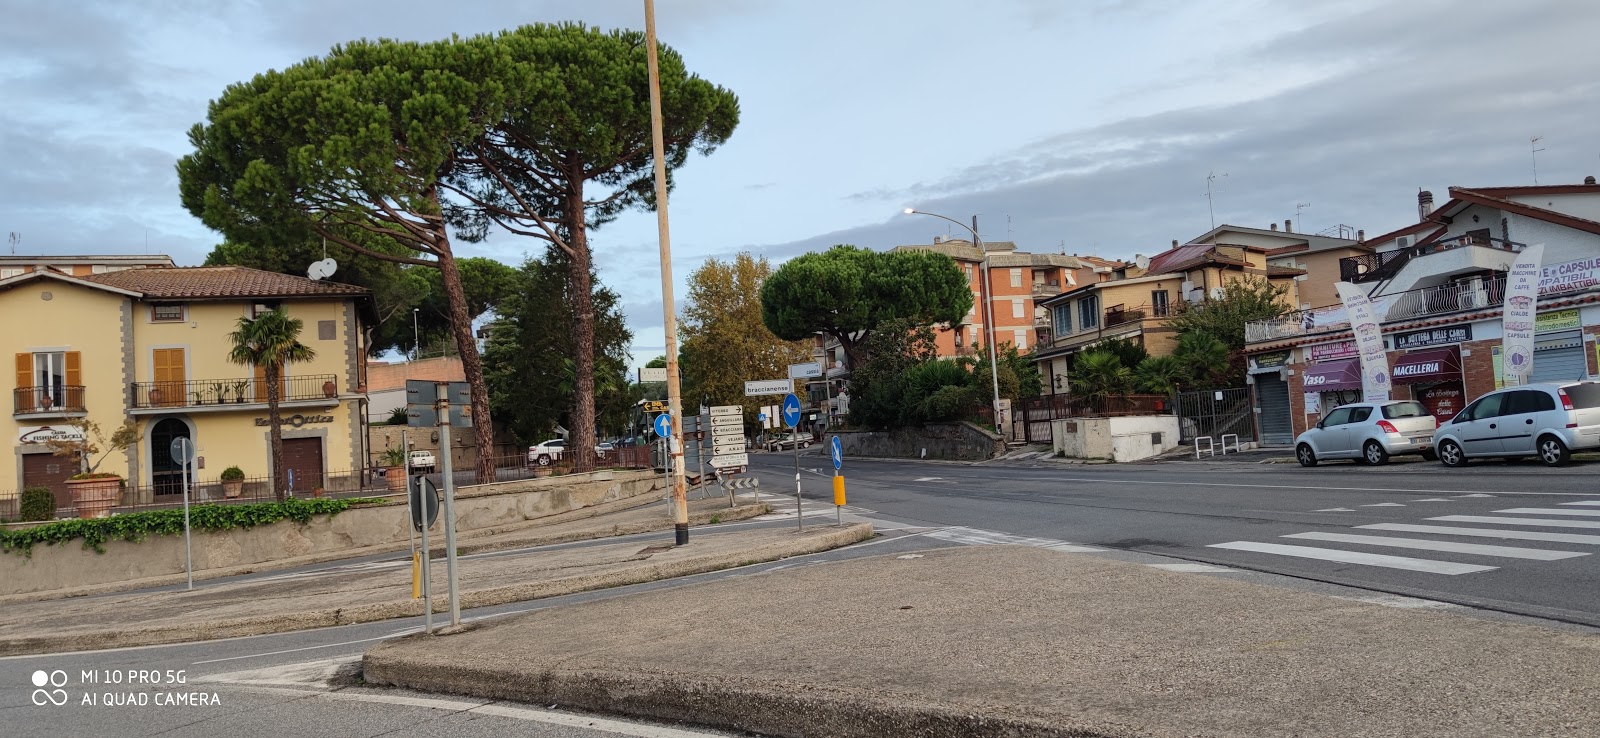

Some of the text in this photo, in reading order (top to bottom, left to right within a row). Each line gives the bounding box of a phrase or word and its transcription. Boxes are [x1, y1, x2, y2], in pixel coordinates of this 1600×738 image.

[1559, 257, 1600, 275] CAPSULE
[1537, 271, 1593, 287] MPATIBILI
[1549, 278, 1600, 293] IMBATTIBIL
[1559, 310, 1578, 318] Tecnica
[1399, 337, 1406, 345] LA
[1407, 331, 1431, 343] BOTTEGA
[1432, 329, 1448, 340] DELLE
[1312, 343, 1342, 351] FORNITURE
[1393, 362, 1439, 376] MACELLERIA
[1303, 375, 1325, 385] Yaso
